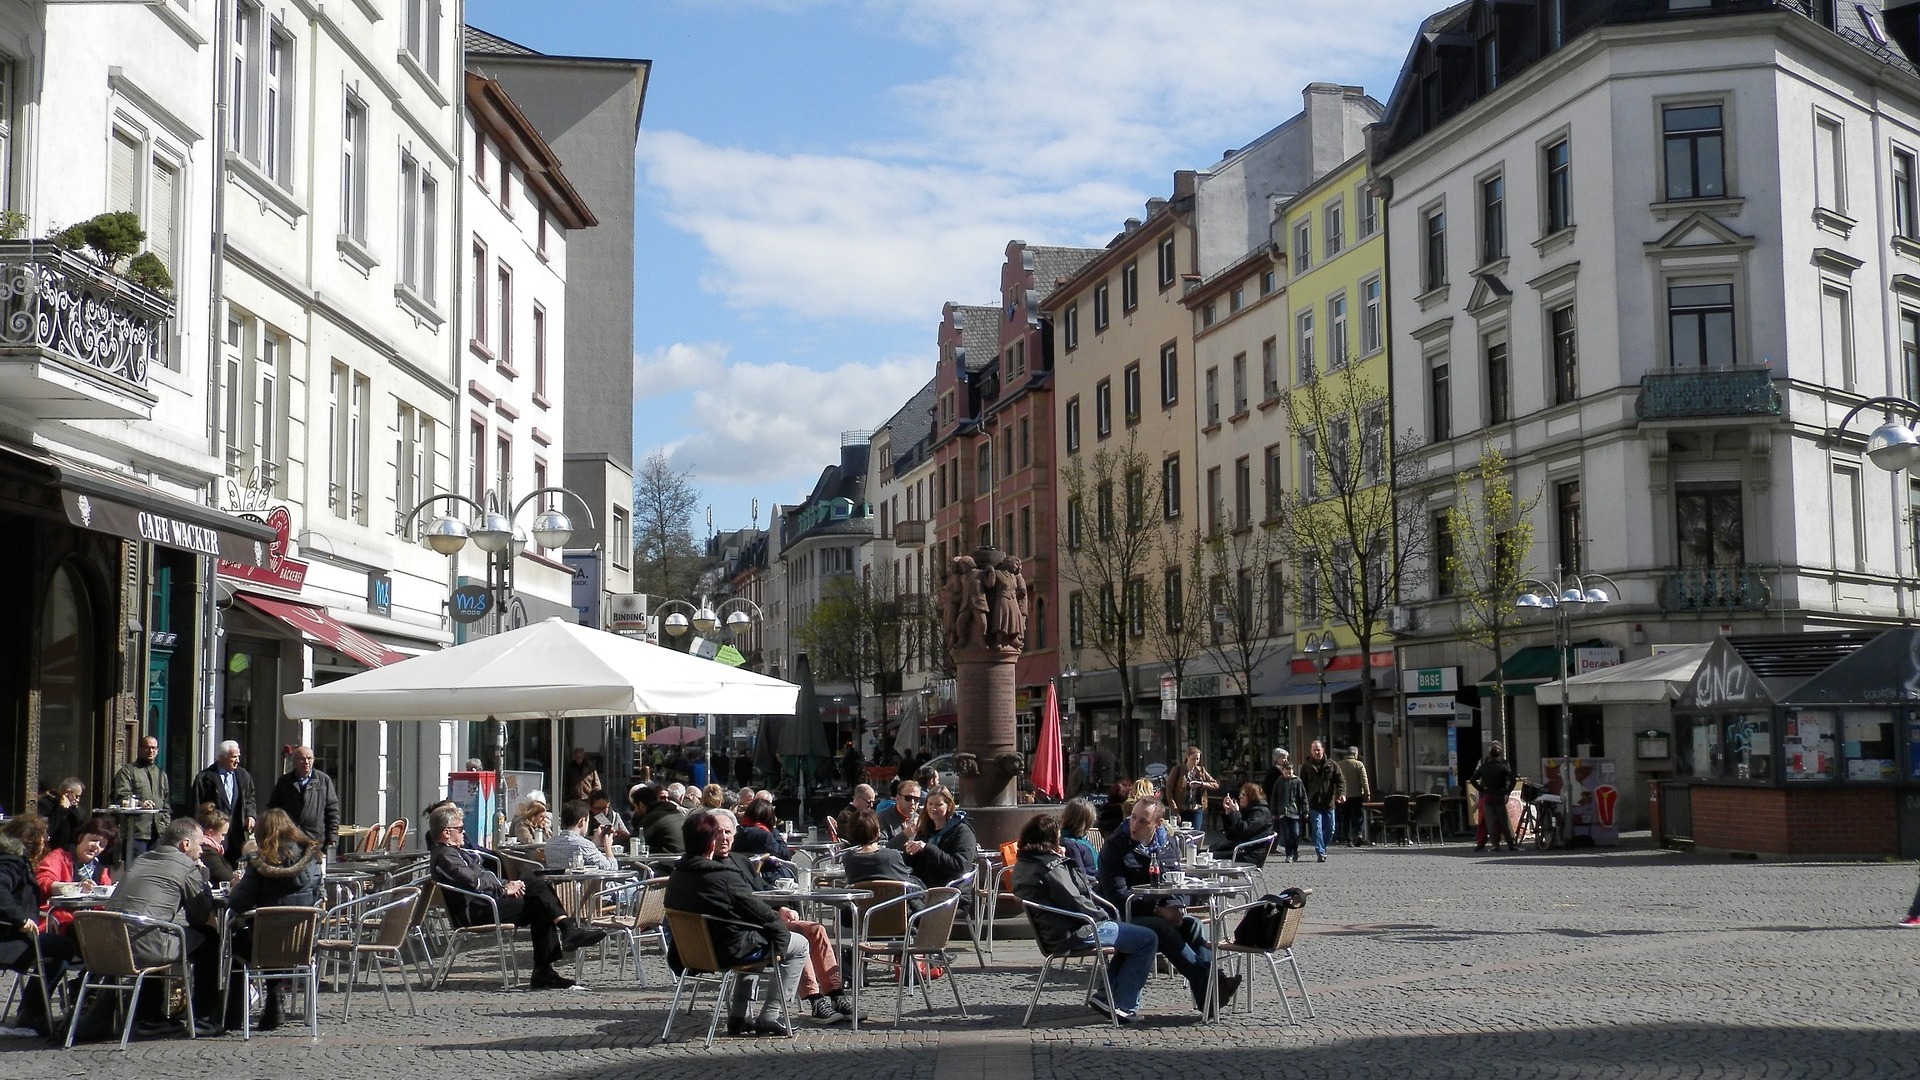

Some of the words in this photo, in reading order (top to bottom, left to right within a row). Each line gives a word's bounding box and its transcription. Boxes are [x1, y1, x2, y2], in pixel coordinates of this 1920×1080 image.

[138, 511, 170, 543] CAFE
[171, 519, 219, 555] WACKER
[613, 612, 645, 622] BINDING
[1581, 659, 1599, 669] Der
[1419, 674, 1440, 687] BASE
